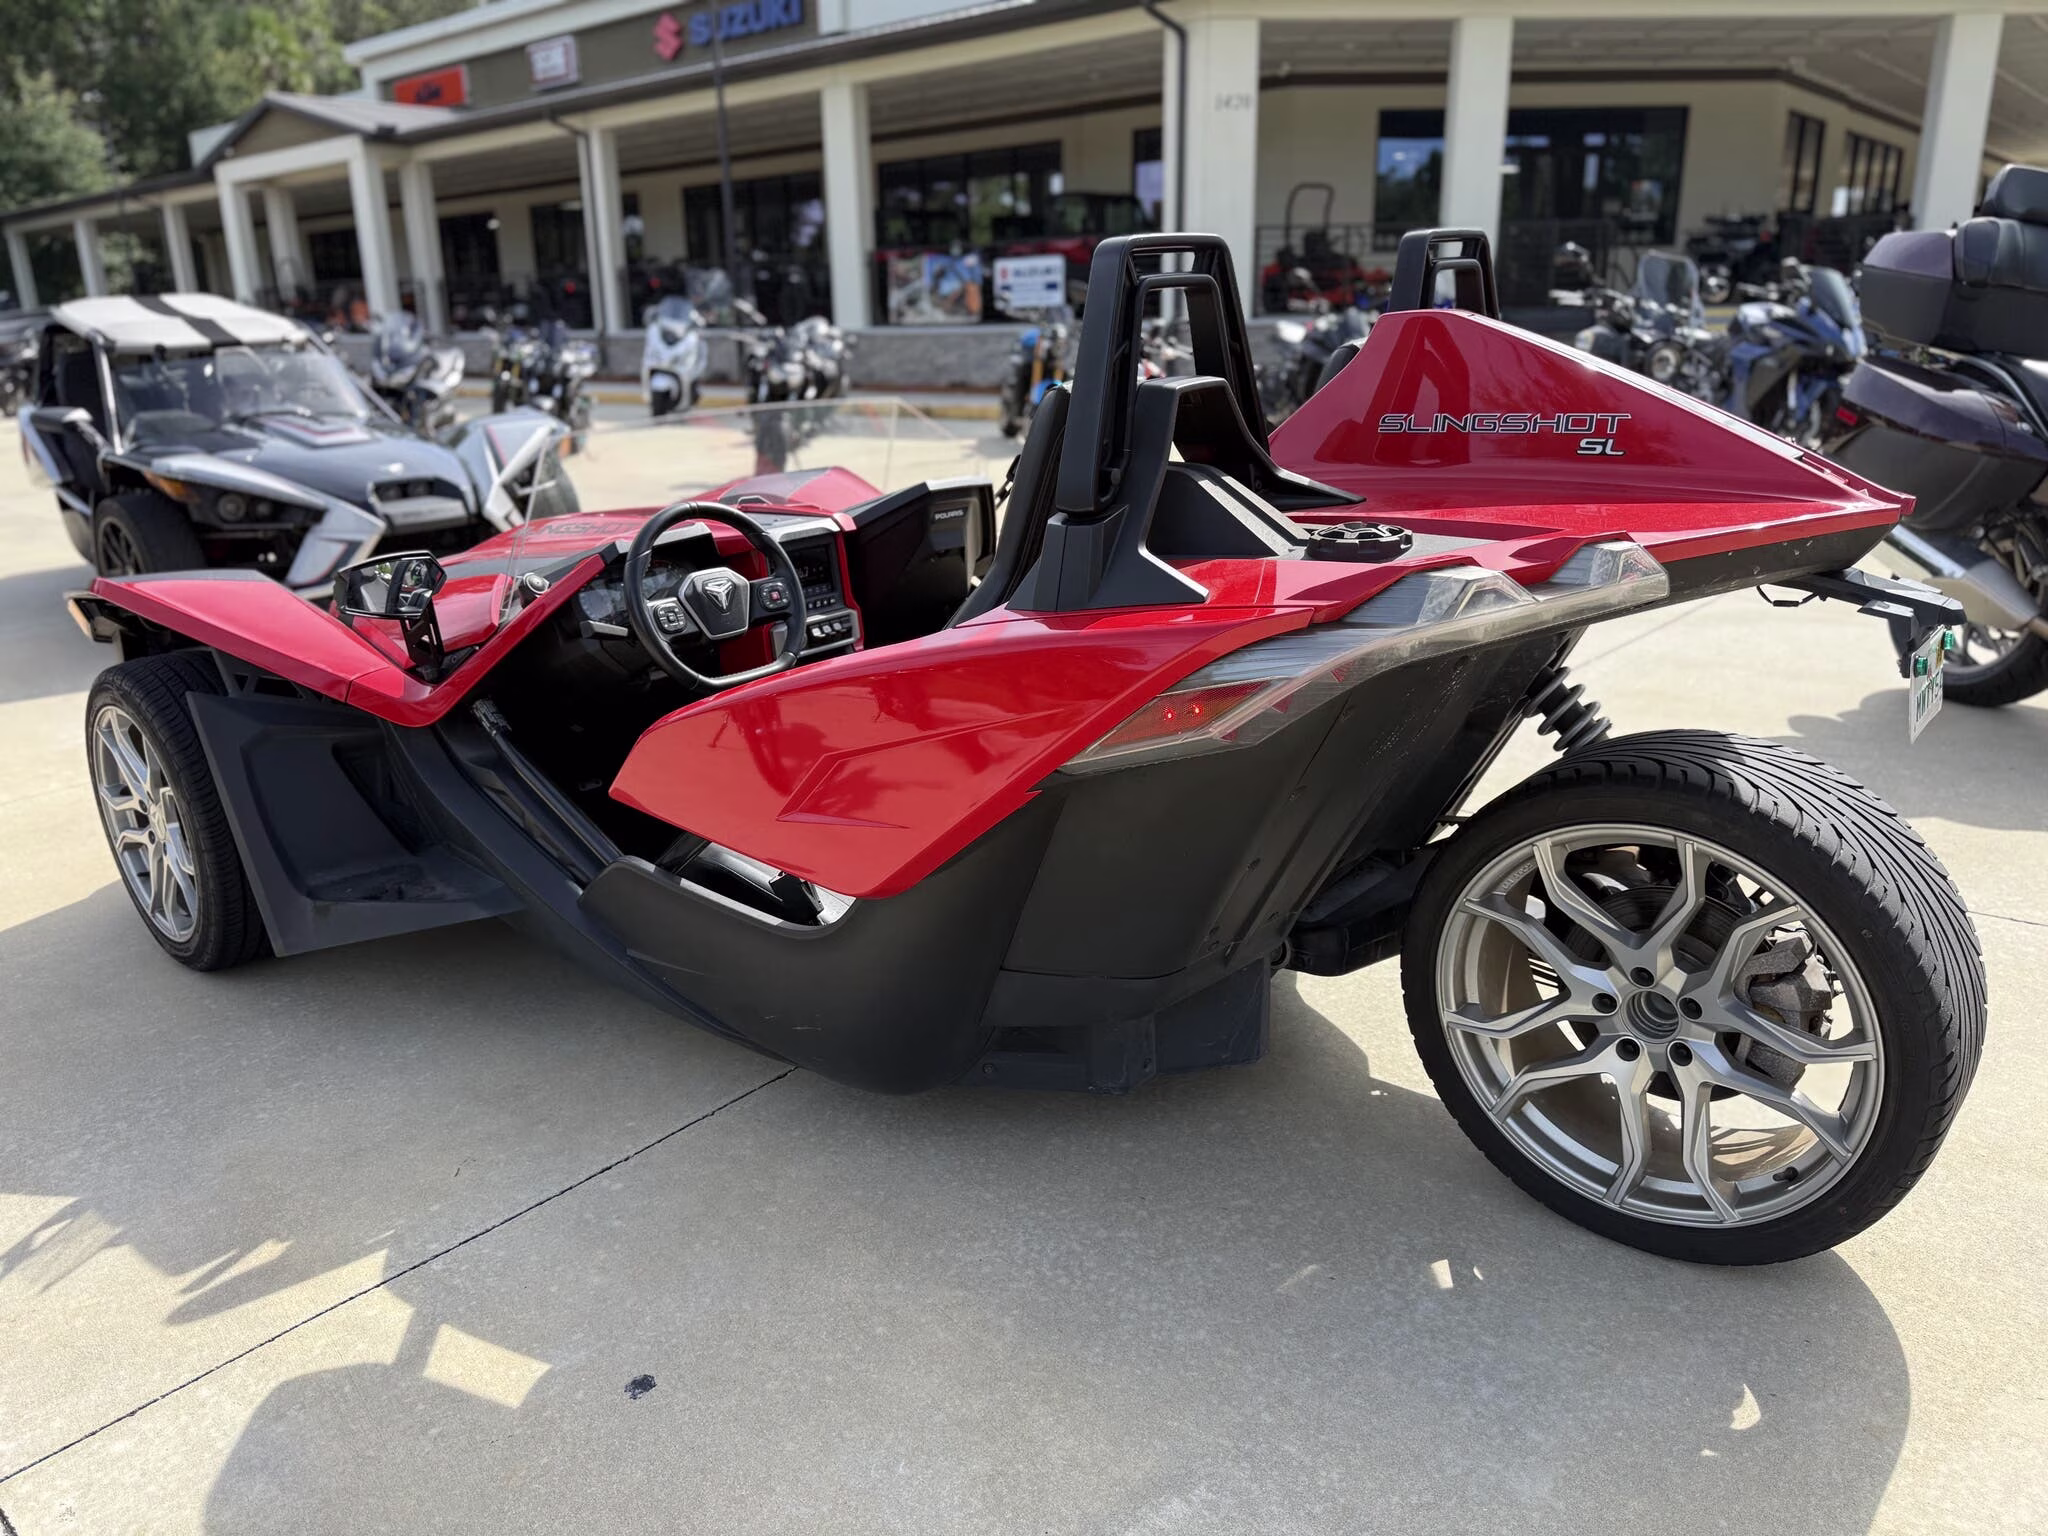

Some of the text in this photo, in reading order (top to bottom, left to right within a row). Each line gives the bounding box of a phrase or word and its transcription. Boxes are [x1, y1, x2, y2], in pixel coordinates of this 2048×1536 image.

[688, 0, 802, 46] SUZUKI
[1378, 413, 1632, 434] SLINGSHOT
[1576, 438, 1625, 456] SL
[934, 509, 964, 520] POLARIS
